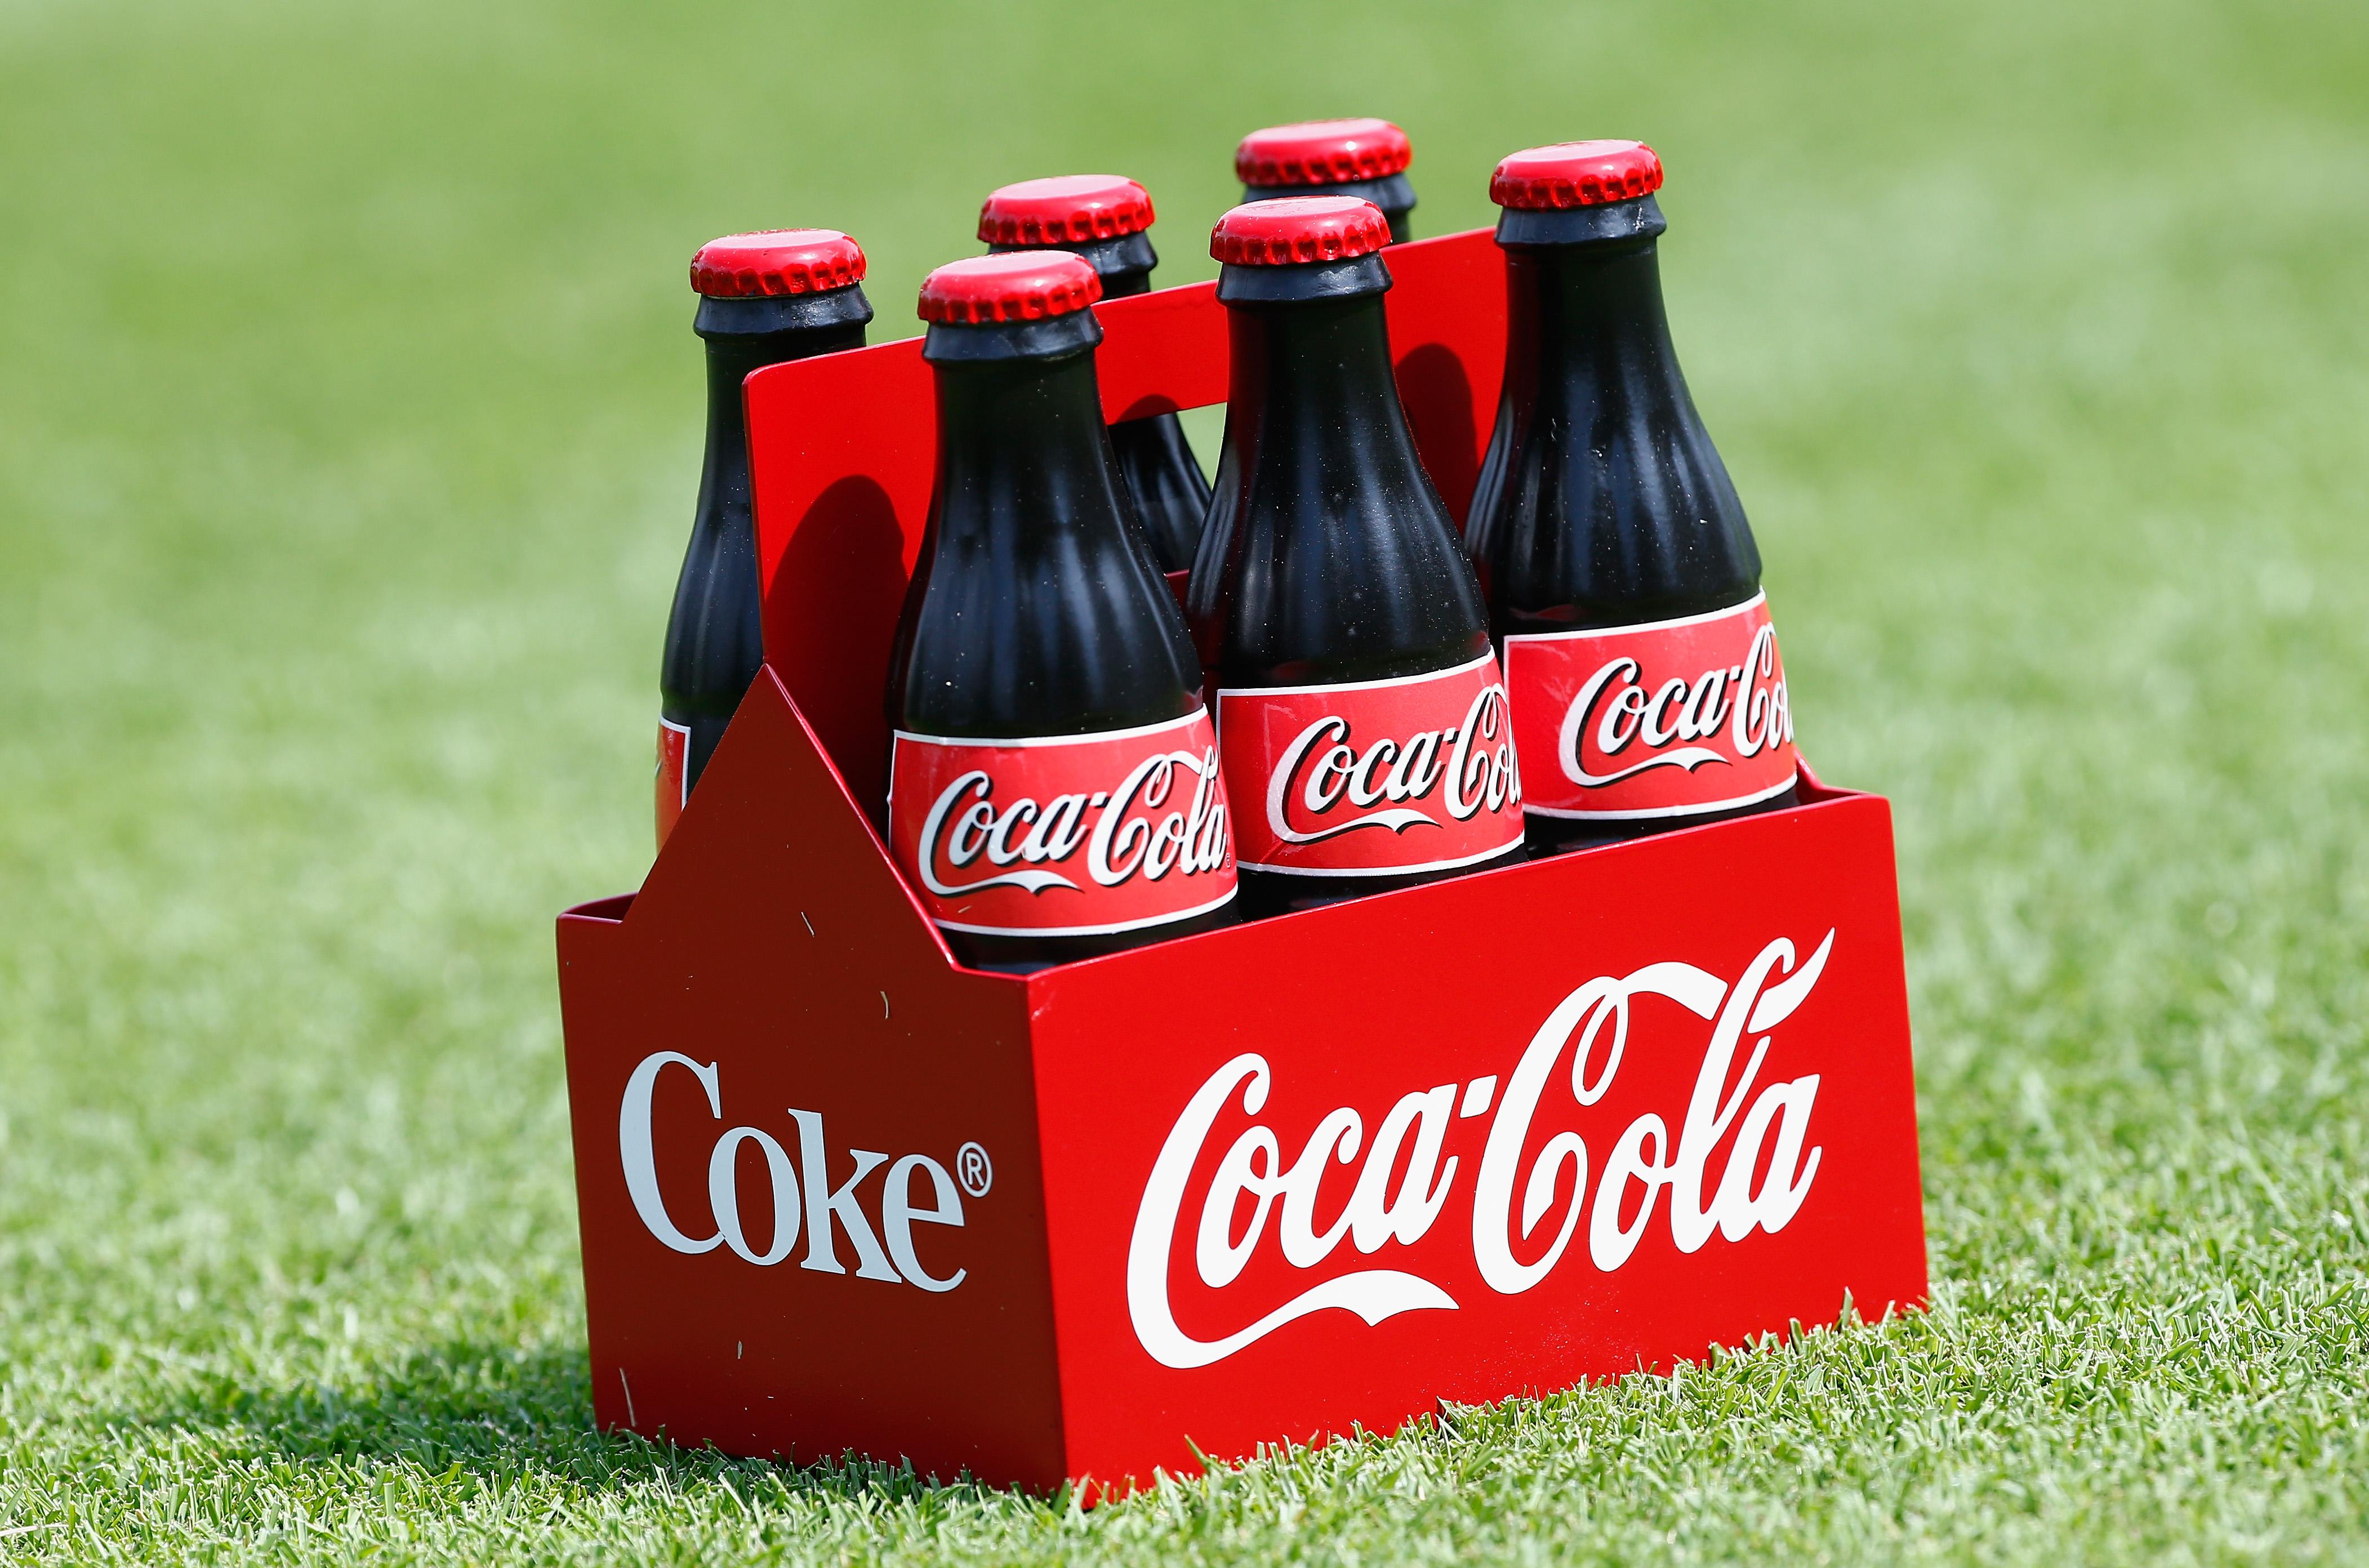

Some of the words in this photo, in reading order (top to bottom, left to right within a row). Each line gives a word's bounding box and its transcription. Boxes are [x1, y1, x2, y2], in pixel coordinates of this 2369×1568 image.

[1557, 622, 1794, 787] Coca-Col
[918, 745, 1229, 897] Coca-Cola
[1127, 928, 1835, 1369] Coca-Cola
